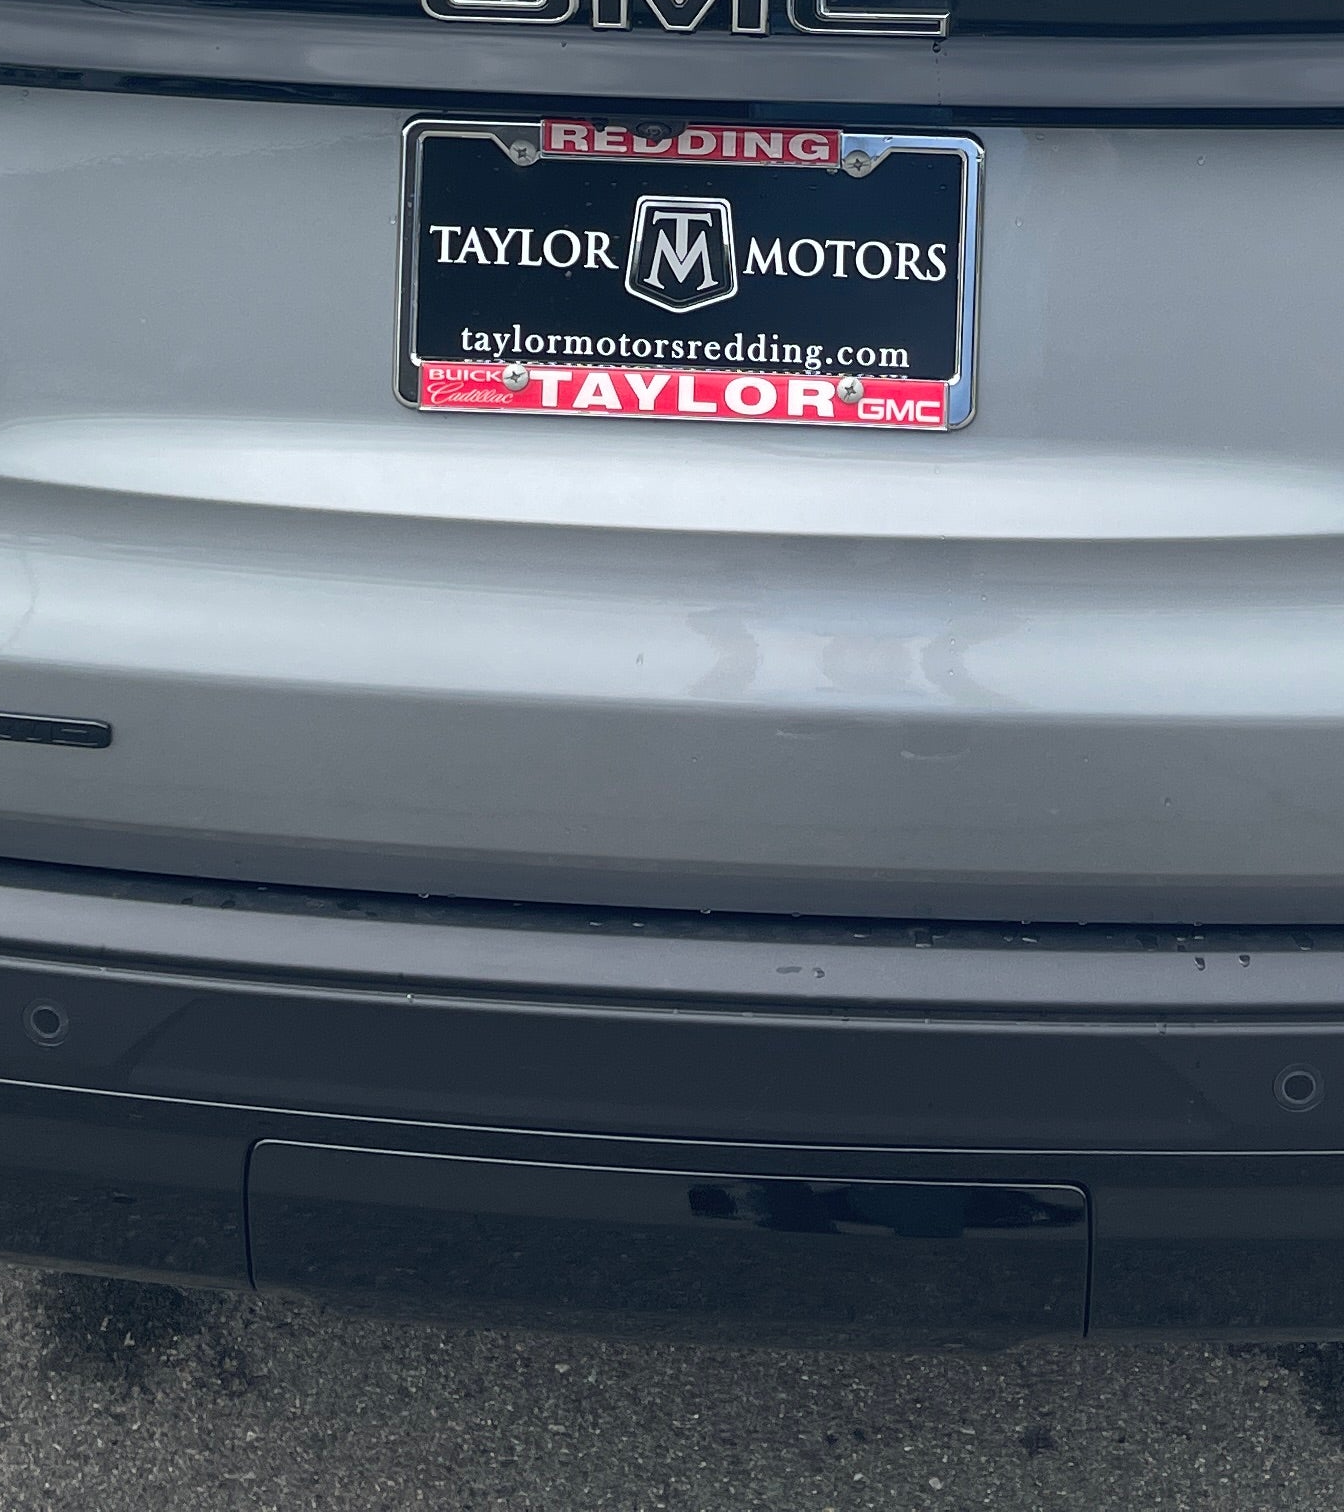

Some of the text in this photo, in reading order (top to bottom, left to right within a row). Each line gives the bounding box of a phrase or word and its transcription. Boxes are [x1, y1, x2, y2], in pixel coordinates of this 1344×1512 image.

[550, 123, 830, 160] REDDING
[429, 225, 620, 270] TAYLOR
[742, 237, 947, 281] MOTORS
[460, 324, 910, 370] taylormotorsredding.com
[427, 381, 515, 405] Cadillac
[428, 368, 503, 383] BUICK
[529, 369, 836, 418] TAYLOR
[857, 398, 941, 423] GMC
